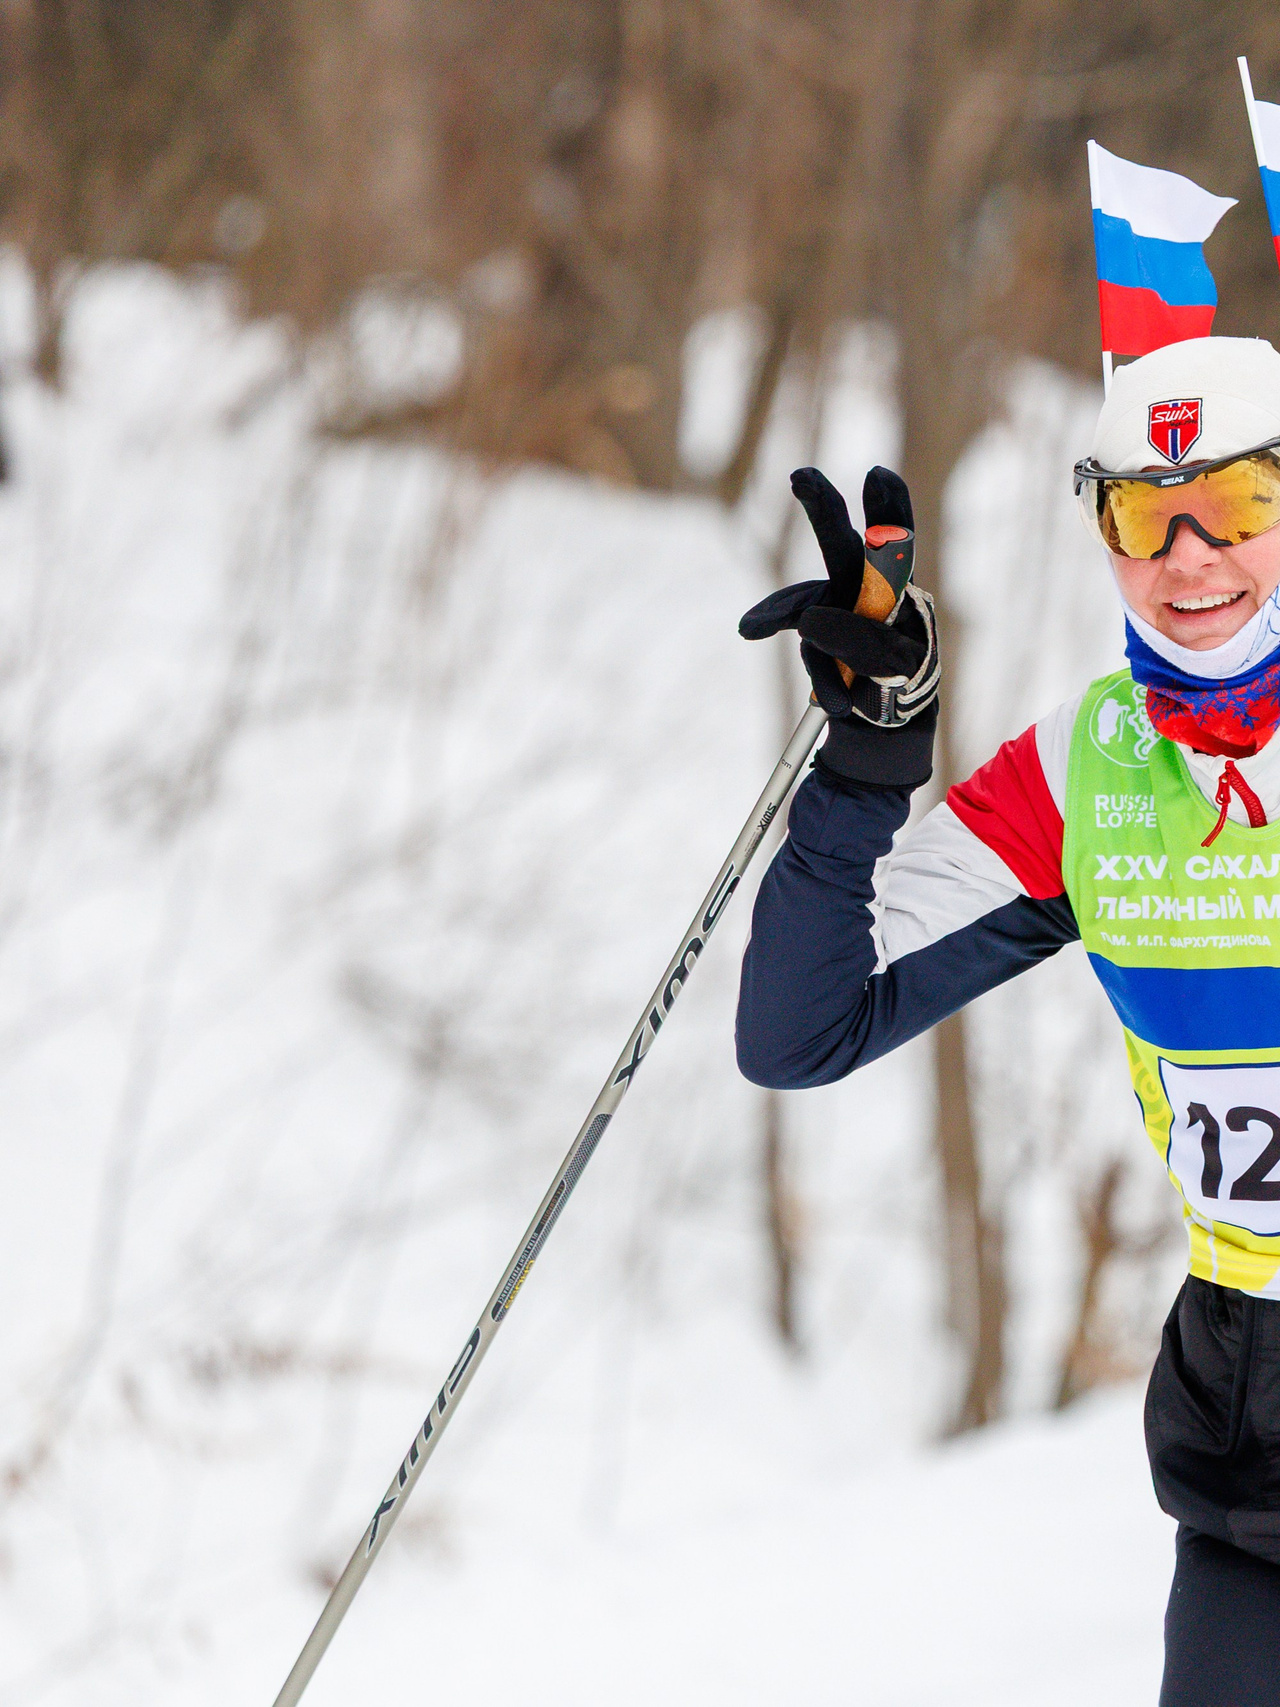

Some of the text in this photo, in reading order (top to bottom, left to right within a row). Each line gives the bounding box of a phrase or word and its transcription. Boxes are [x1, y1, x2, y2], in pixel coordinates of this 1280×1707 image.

[1161, 476, 1185, 486] RELAX
[757, 802, 777, 831] SWIX
[1094, 854, 1172, 881] XXV
[1095, 887, 1246, 921] ЛЫЖНЫЙ
